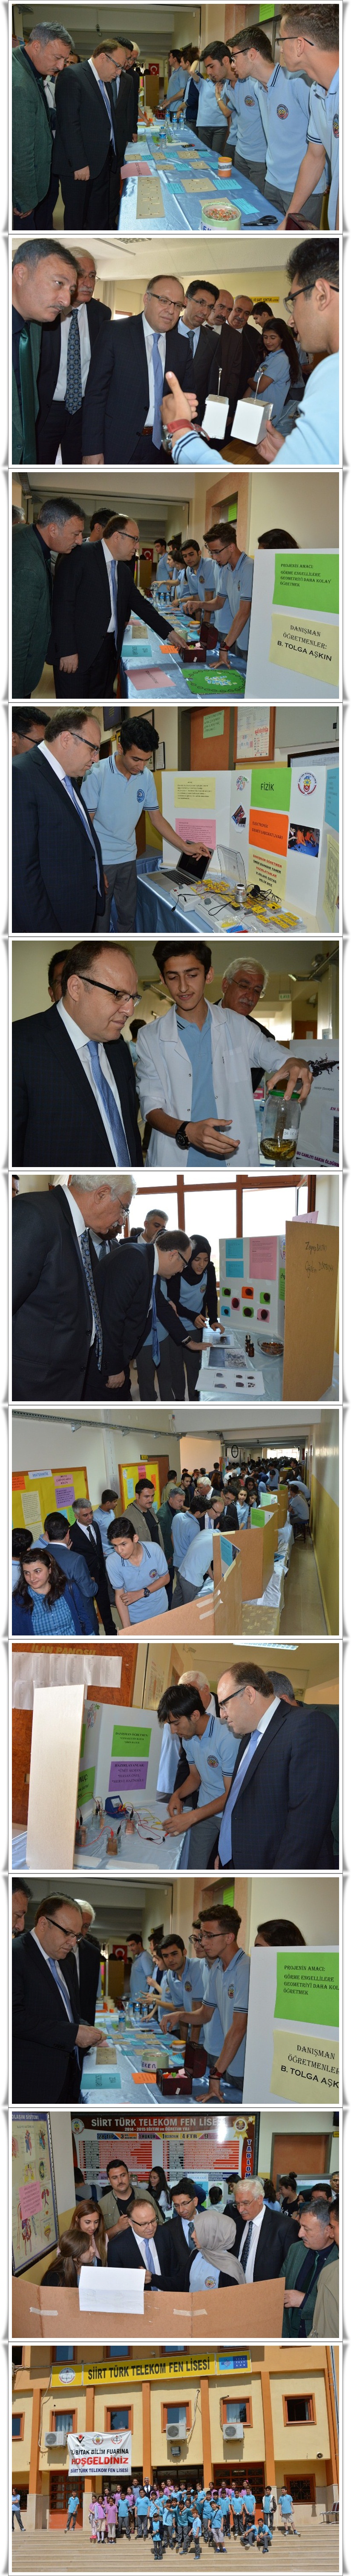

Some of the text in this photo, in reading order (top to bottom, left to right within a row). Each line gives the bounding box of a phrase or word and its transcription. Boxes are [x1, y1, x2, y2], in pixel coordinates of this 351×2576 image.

[290, 625, 321, 637] DANIŞMAN
[283, 631, 327, 649] ÖĞRETMENLER:
[285, 643, 308, 654] TOLGA
[309, 651, 332, 661] AŞKIN
[261, 782, 274, 791] FİZİK
[261, 830, 283, 839] LABORATUVARI
[31, 1643, 53, 1653] İLAN
[297, 2045, 335, 2060] DANIŞMAN
[290, 2068, 319, 2082] TOLGA
[321, 2078, 339, 2088] AŞK
[91, 2117, 112, 2127] SİİRT
[115, 2117, 137, 2127] TÜRK
[139, 2118, 177, 2126] TELEKOM
[88, 2366, 107, 2380] SİİRT
[109, 2365, 129, 2378] TÜRK
[131, 2362, 166, 2376] TELEKOM
[169, 2361, 183, 2373] FEN
[186, 2356, 210, 2371] LİSESİ
